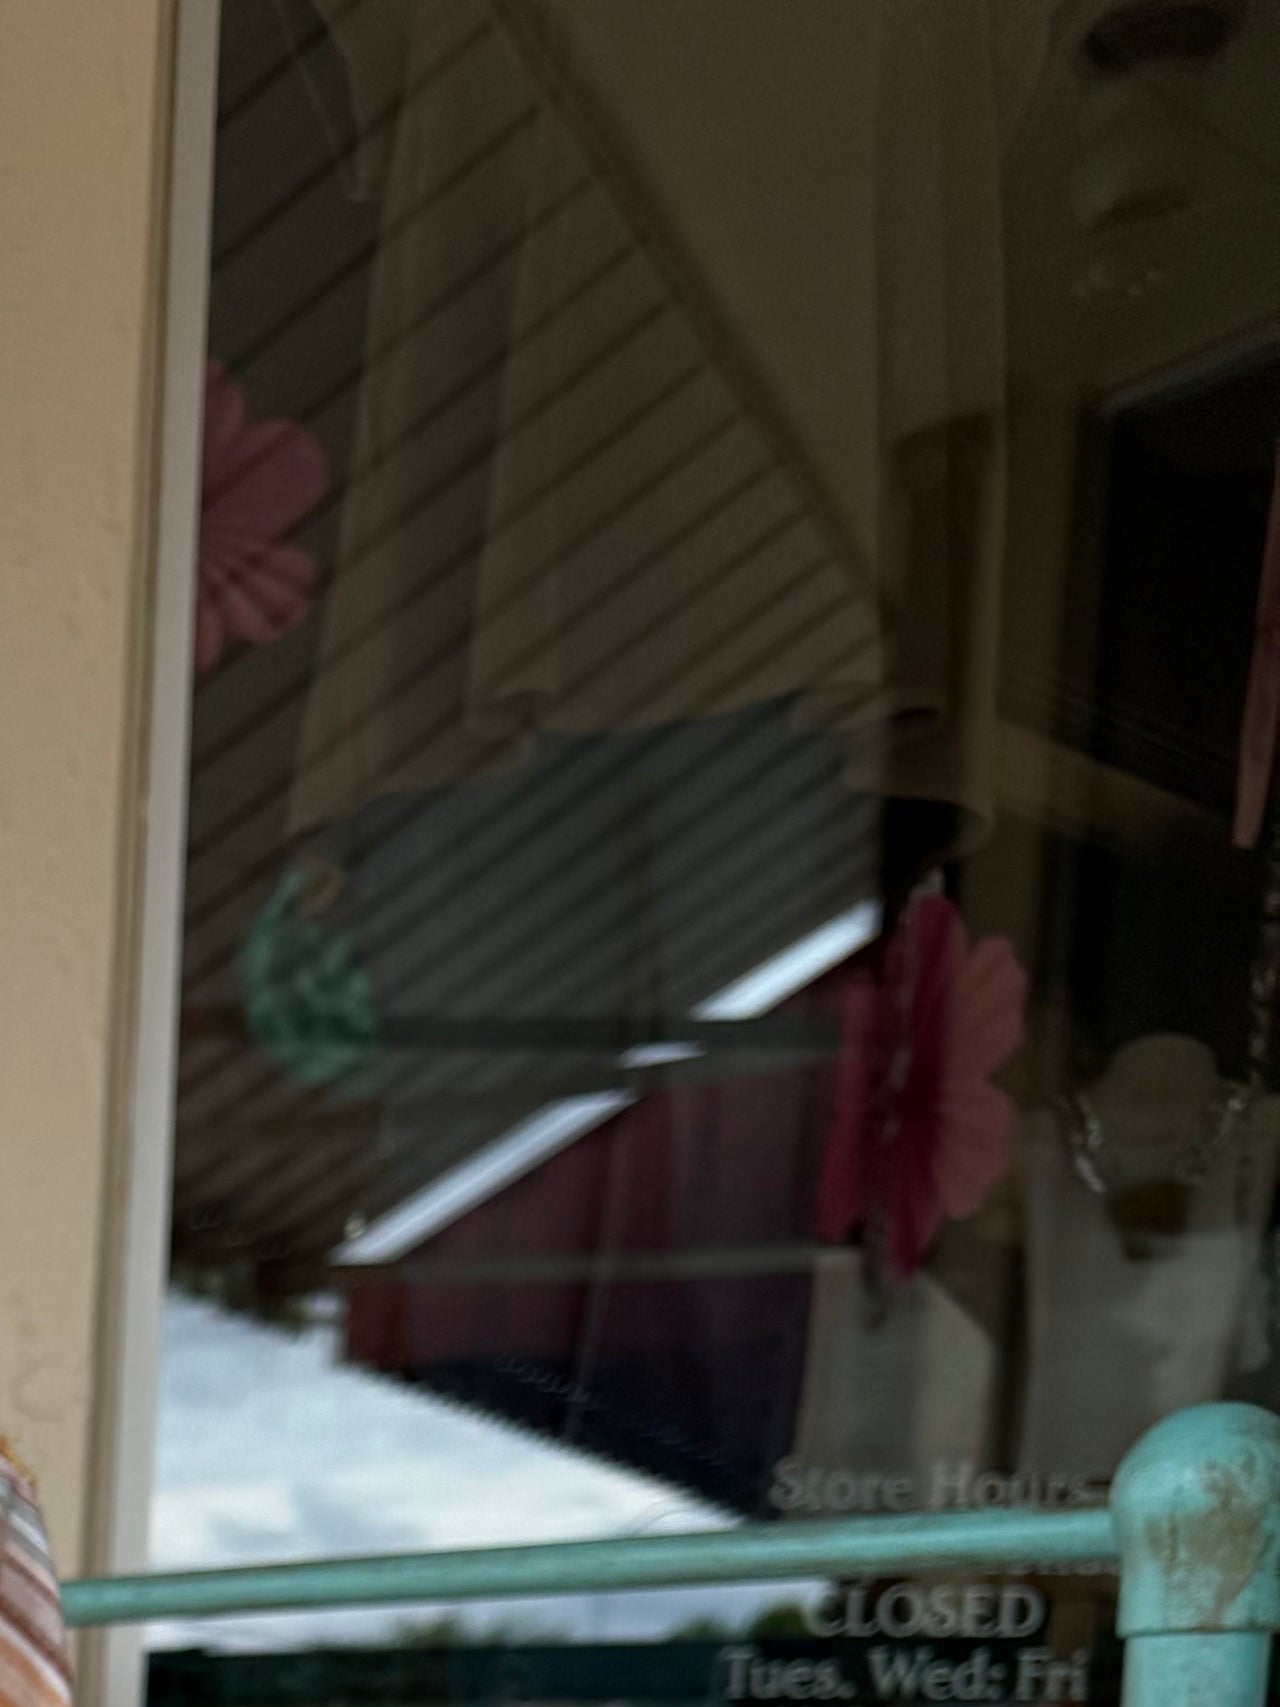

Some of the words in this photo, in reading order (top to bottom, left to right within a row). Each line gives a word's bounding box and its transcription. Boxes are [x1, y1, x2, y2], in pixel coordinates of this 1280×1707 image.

[771, 1457, 915, 1511] Store
[928, 1457, 1092, 1510] Hours
[804, 1582, 1046, 1639] CLOSED
[1014, 1646, 1090, 1701] Fri
